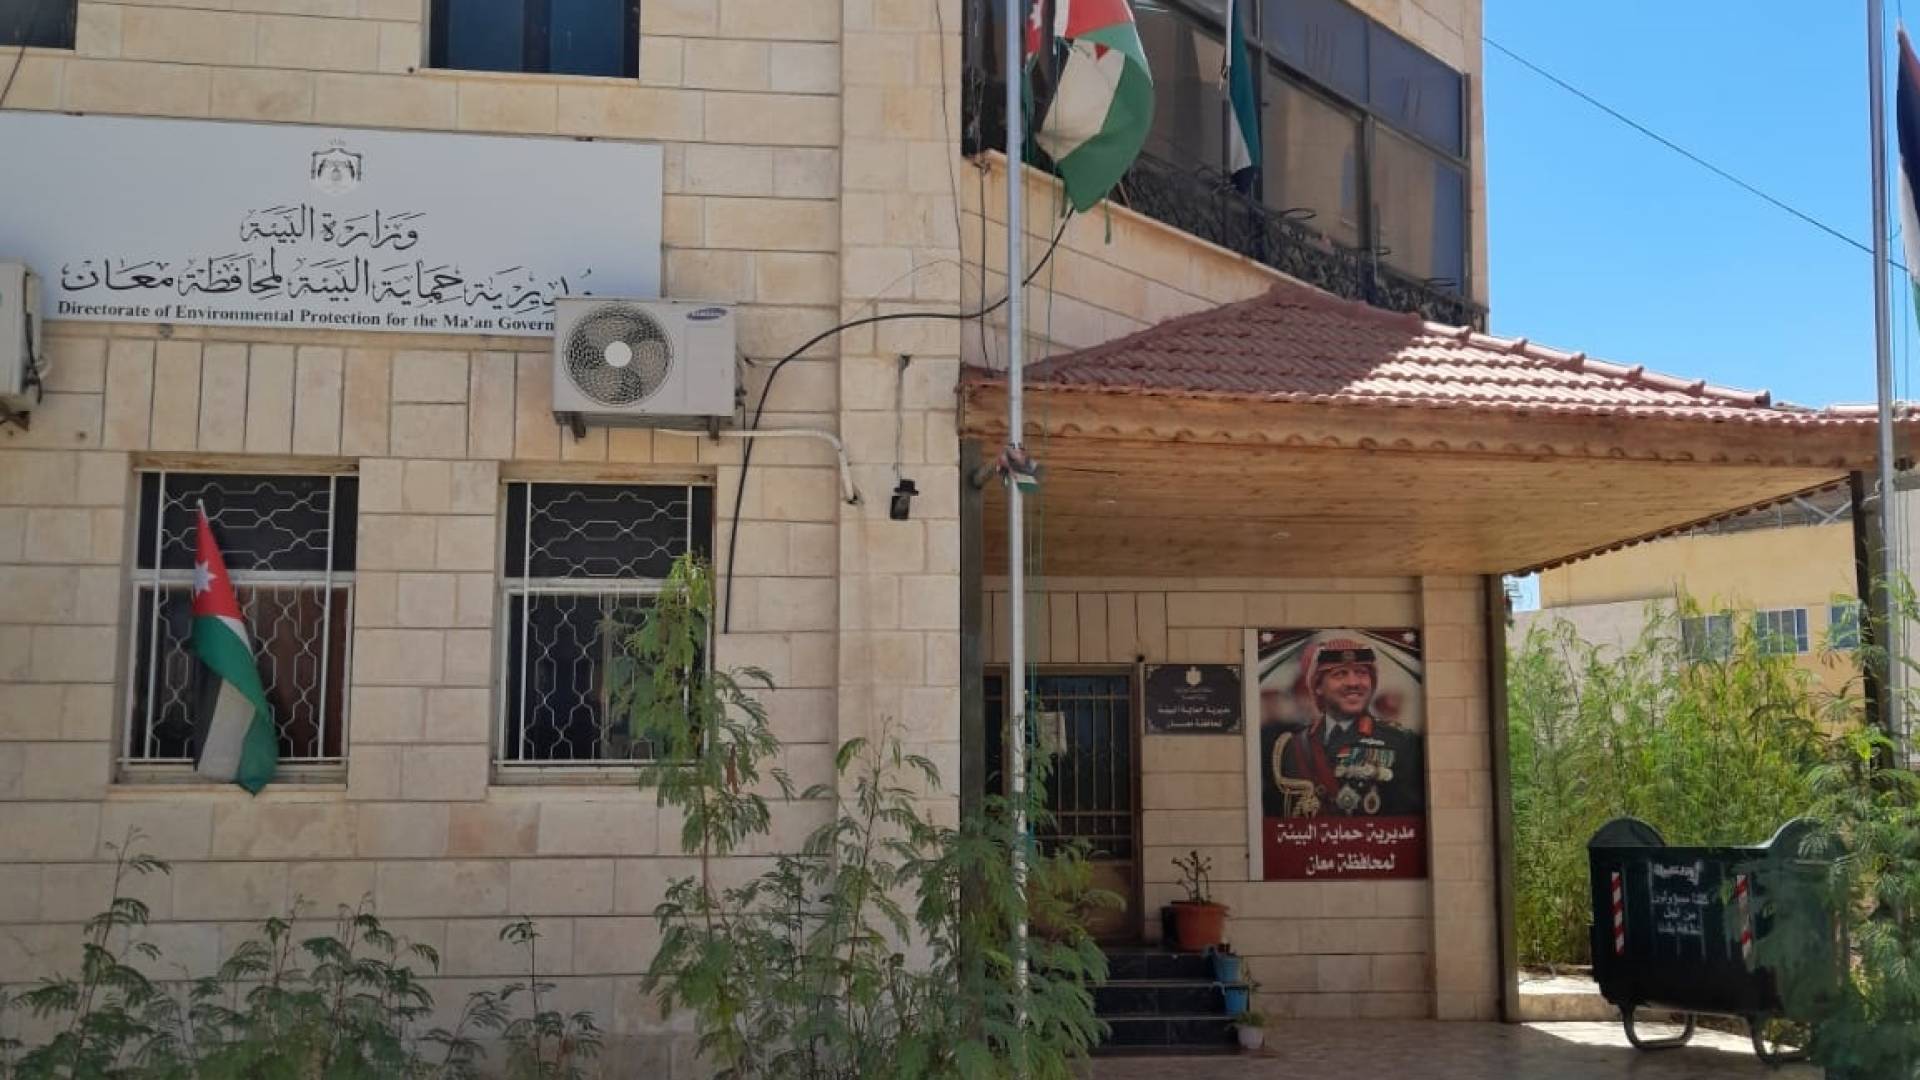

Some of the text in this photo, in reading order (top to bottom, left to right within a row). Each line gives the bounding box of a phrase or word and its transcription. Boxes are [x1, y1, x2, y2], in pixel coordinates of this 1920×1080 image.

[240, 203, 426, 250] وزارة البيئة
[61, 246, 592, 312] ديرية حماية البيئة لمحافظة معان
[58, 300, 150, 317] Directorate
[154, 304, 172, 318] of
[175, 304, 294, 322] Environmental
[300, 309, 380, 327] Protection
[386, 311, 407, 327] for
[413, 313, 438, 328] the
[498, 317, 555, 331] Govern
[1277, 823, 1415, 846] مديرية حماية البيئة
[1305, 852, 1395, 876] لمحافظة معان
